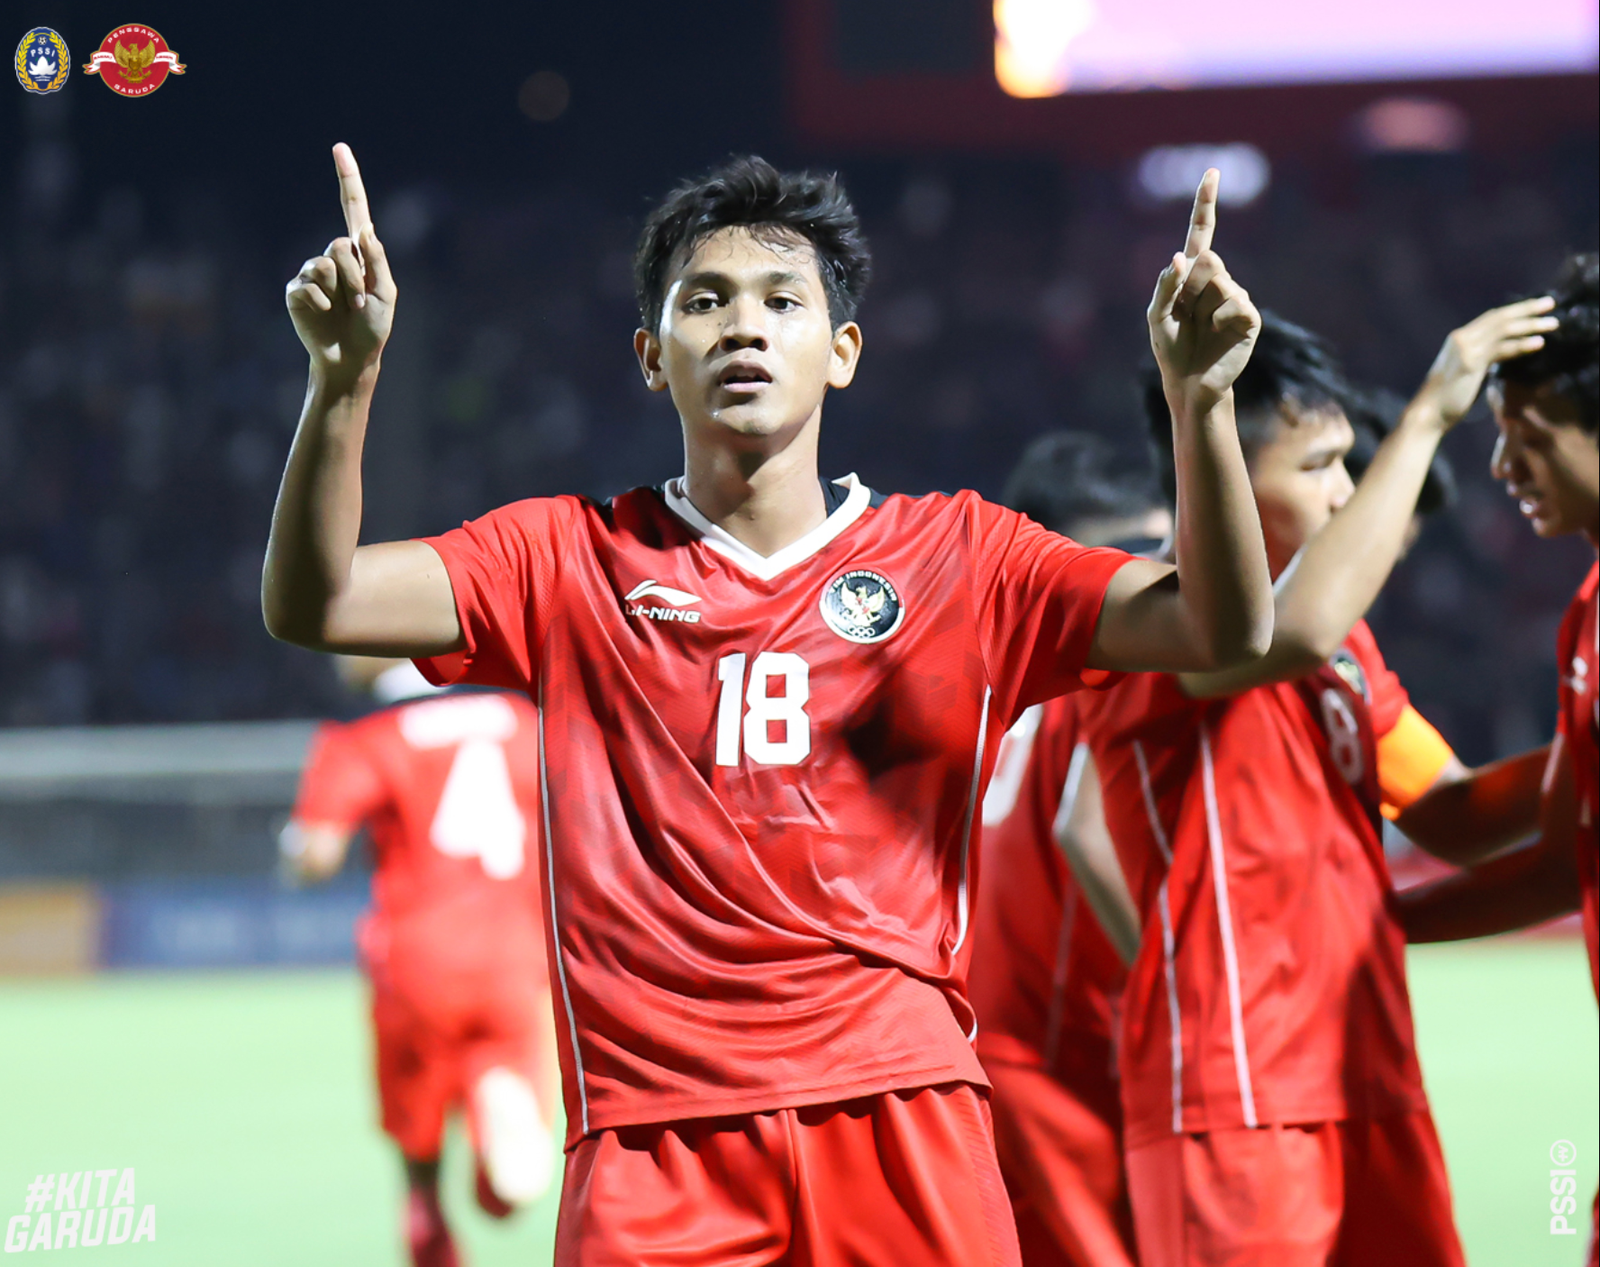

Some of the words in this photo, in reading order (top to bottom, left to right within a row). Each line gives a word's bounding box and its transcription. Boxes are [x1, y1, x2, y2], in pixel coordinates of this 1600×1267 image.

[625, 604, 702, 624] LI-NING
[845, 569, 898, 602] INDONESIA
[716, 651, 812, 767] 18
[1321, 687, 1364, 785] 8
[429, 738, 528, 881] 4
